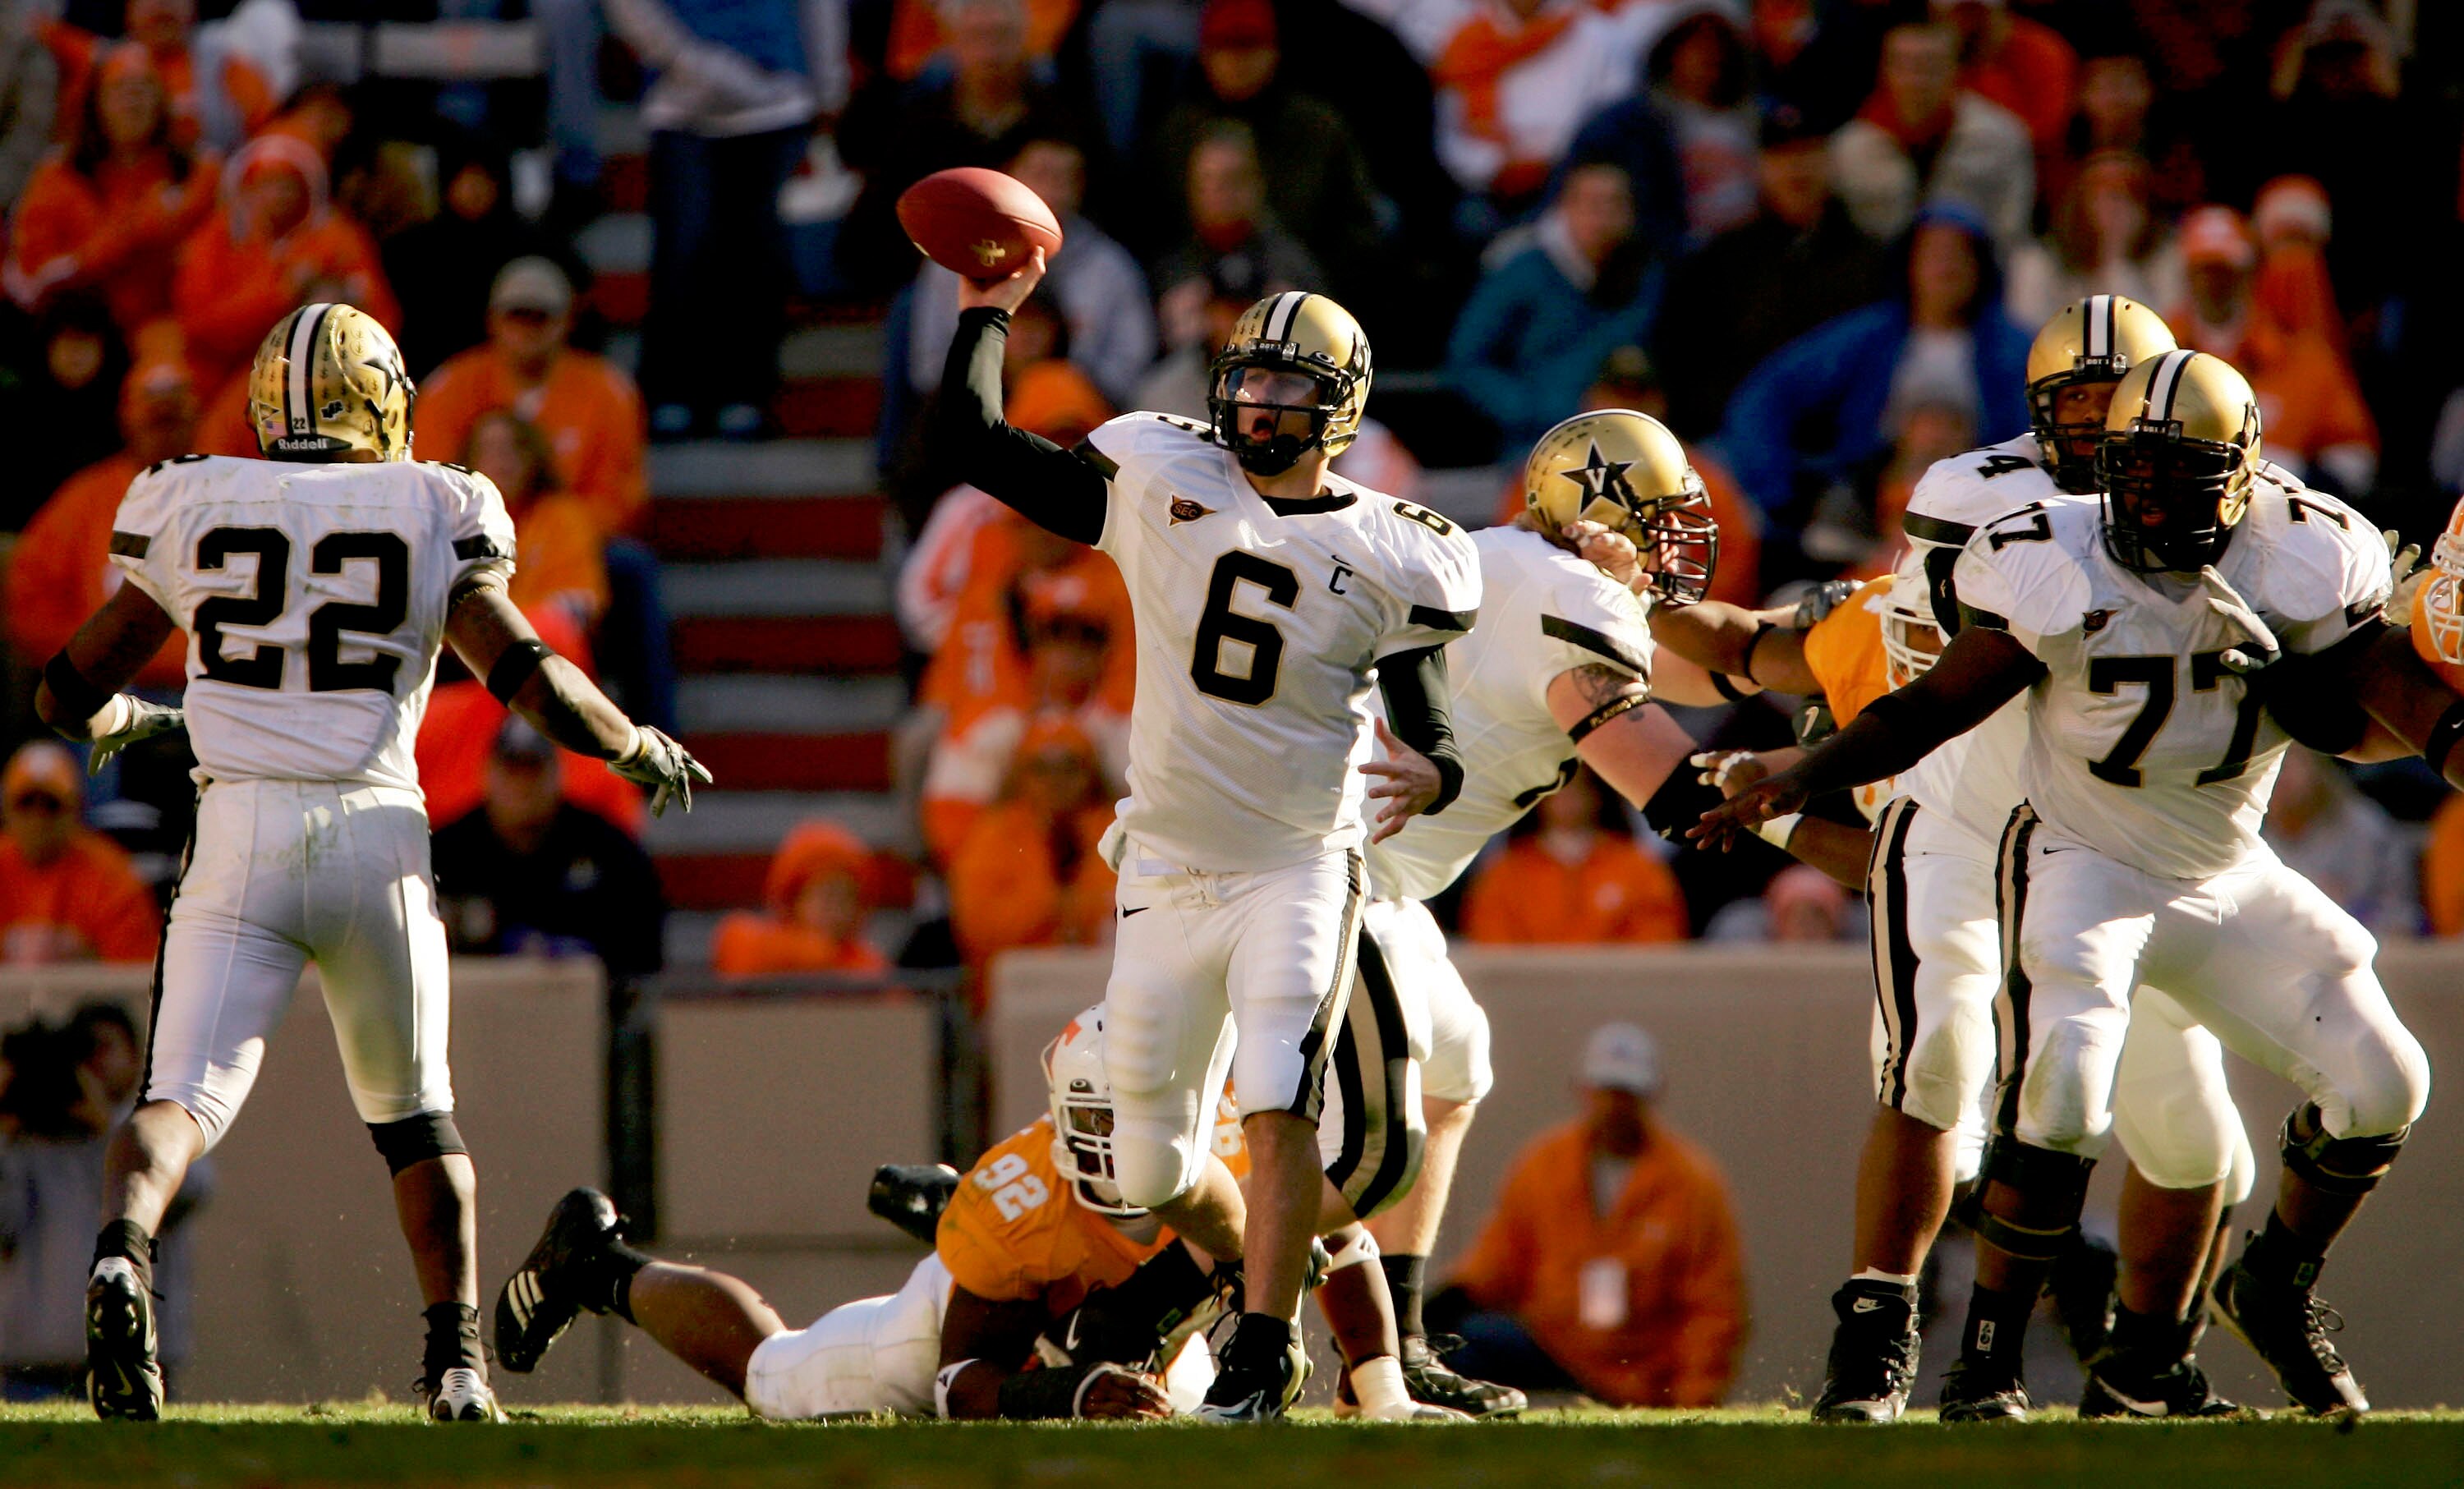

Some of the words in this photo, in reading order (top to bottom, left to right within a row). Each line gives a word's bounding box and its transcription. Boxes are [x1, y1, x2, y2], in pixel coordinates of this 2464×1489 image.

[292, 417, 306, 430] 22
[277, 437, 329, 451] Riddell
[1173, 504, 1198, 518] SEC
[1391, 502, 1455, 538] 6
[1329, 565, 1354, 595] C
[191, 524, 411, 696] 22
[1189, 546, 1303, 710] 6
[2087, 650, 2264, 789] 77
[973, 1153, 1050, 1223] 92
